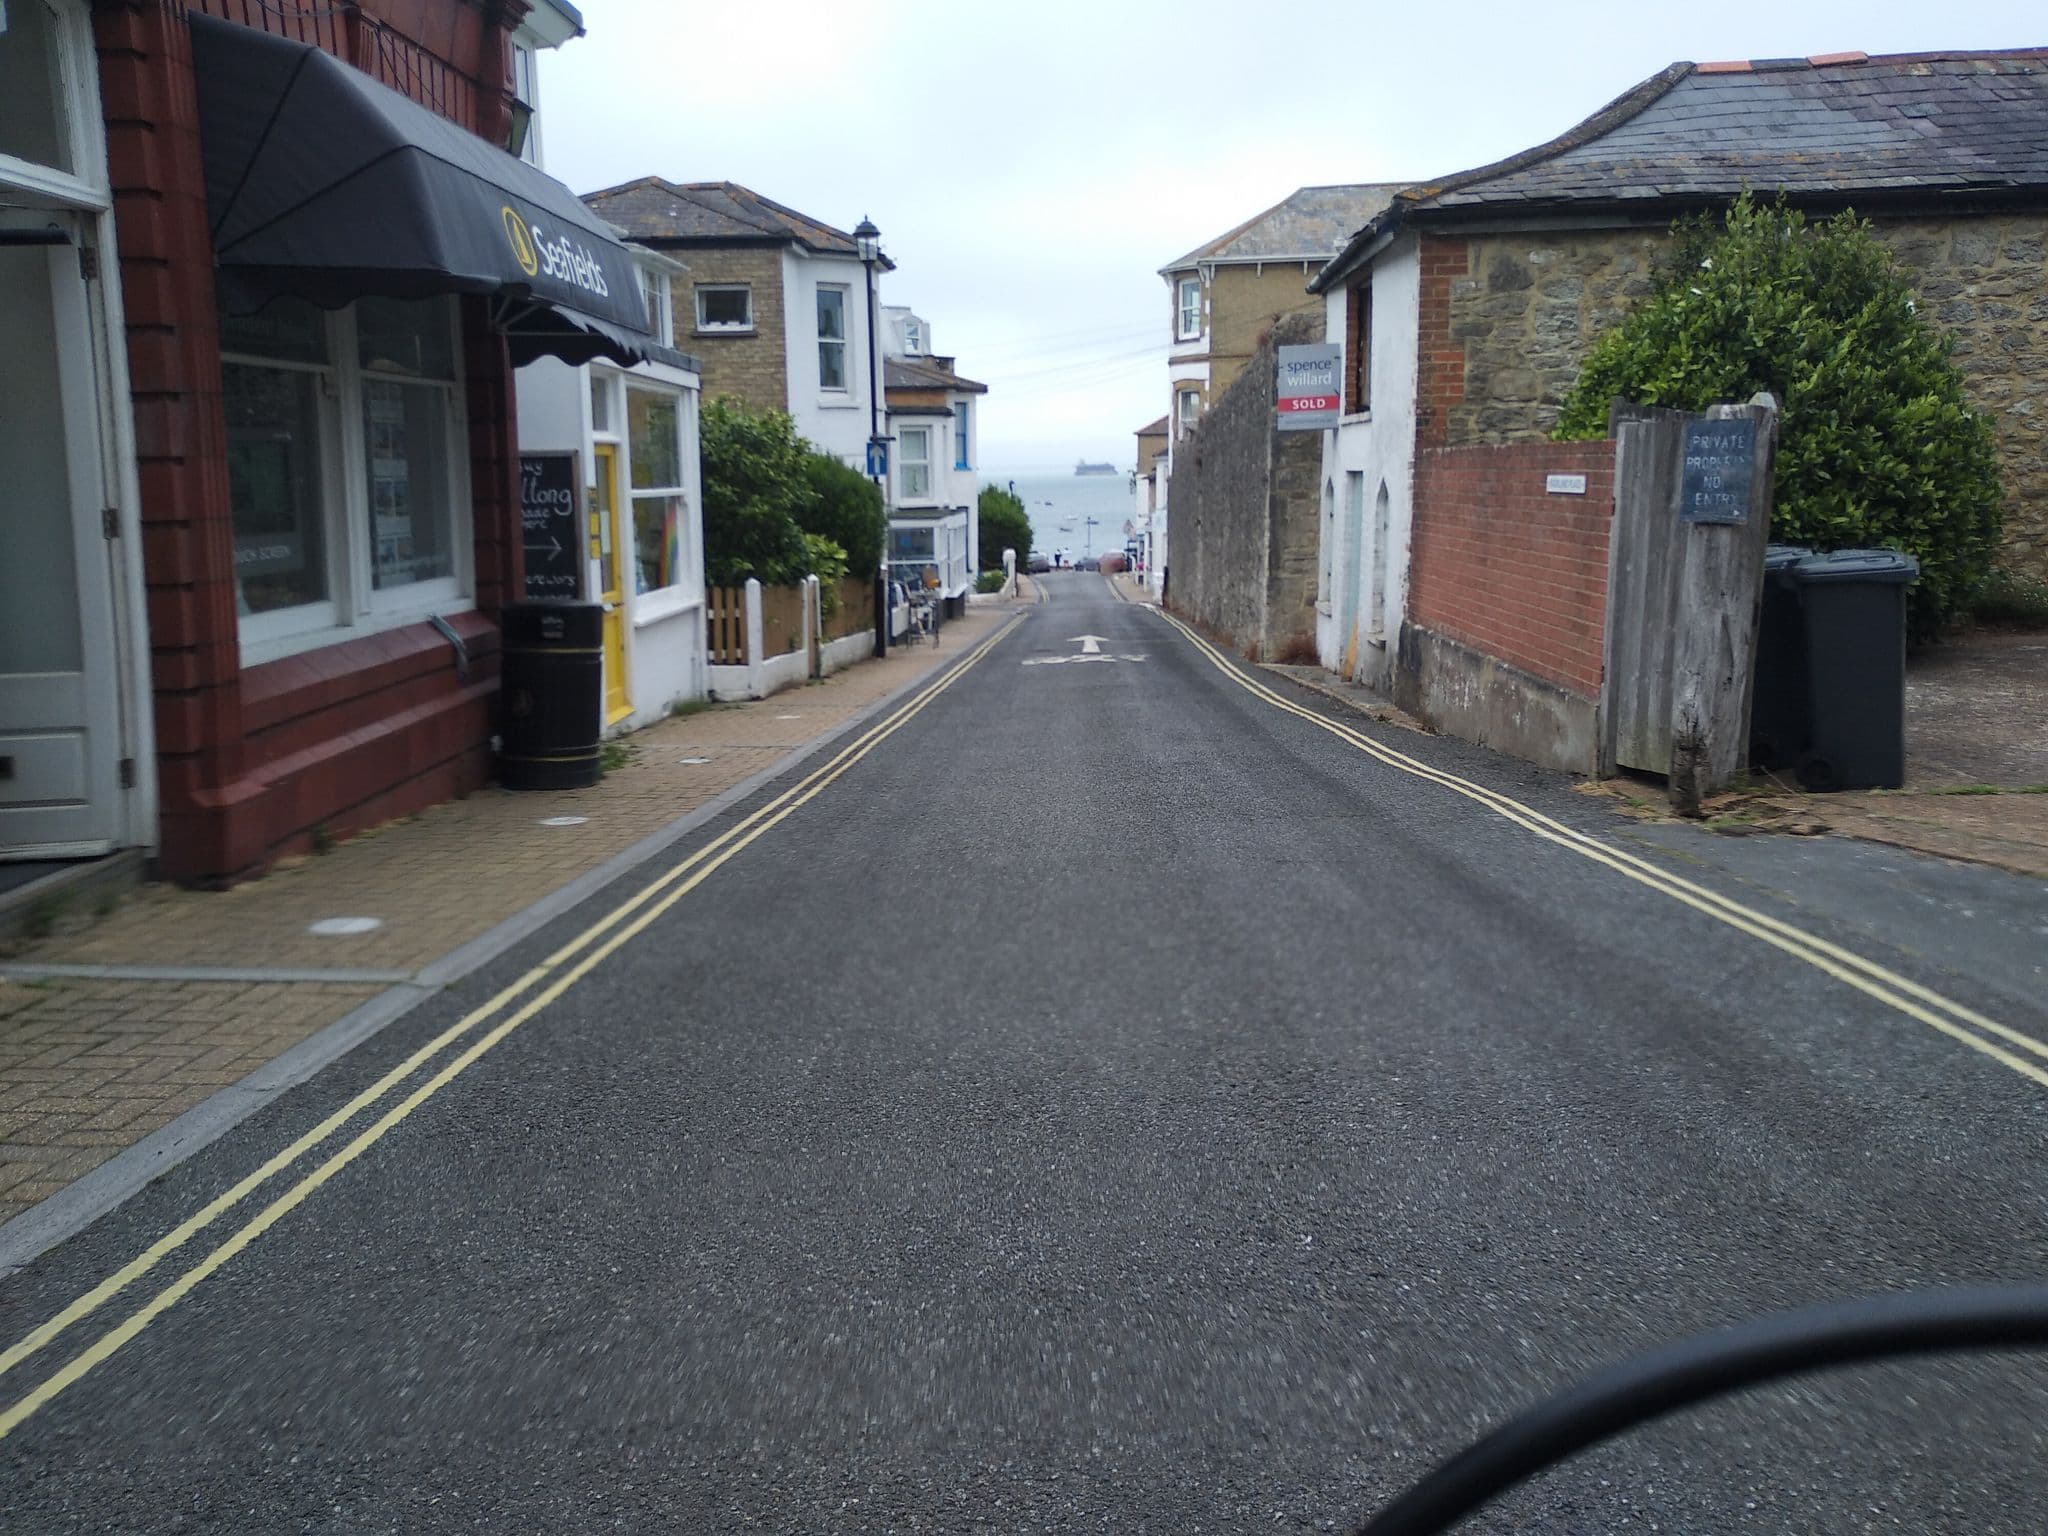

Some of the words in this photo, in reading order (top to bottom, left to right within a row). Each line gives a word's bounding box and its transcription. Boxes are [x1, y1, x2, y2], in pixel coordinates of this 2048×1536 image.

[531, 225, 609, 298] Seafields
[1287, 360, 1332, 374] spence
[1287, 371, 1332, 387] willard
[1292, 398, 1326, 410] SOLD
[1692, 435, 1745, 449] PRIVATE
[1686, 455, 1750, 470] PROP
[1703, 475, 1721, 489] NO
[1695, 492, 1737, 506] ENTRY
